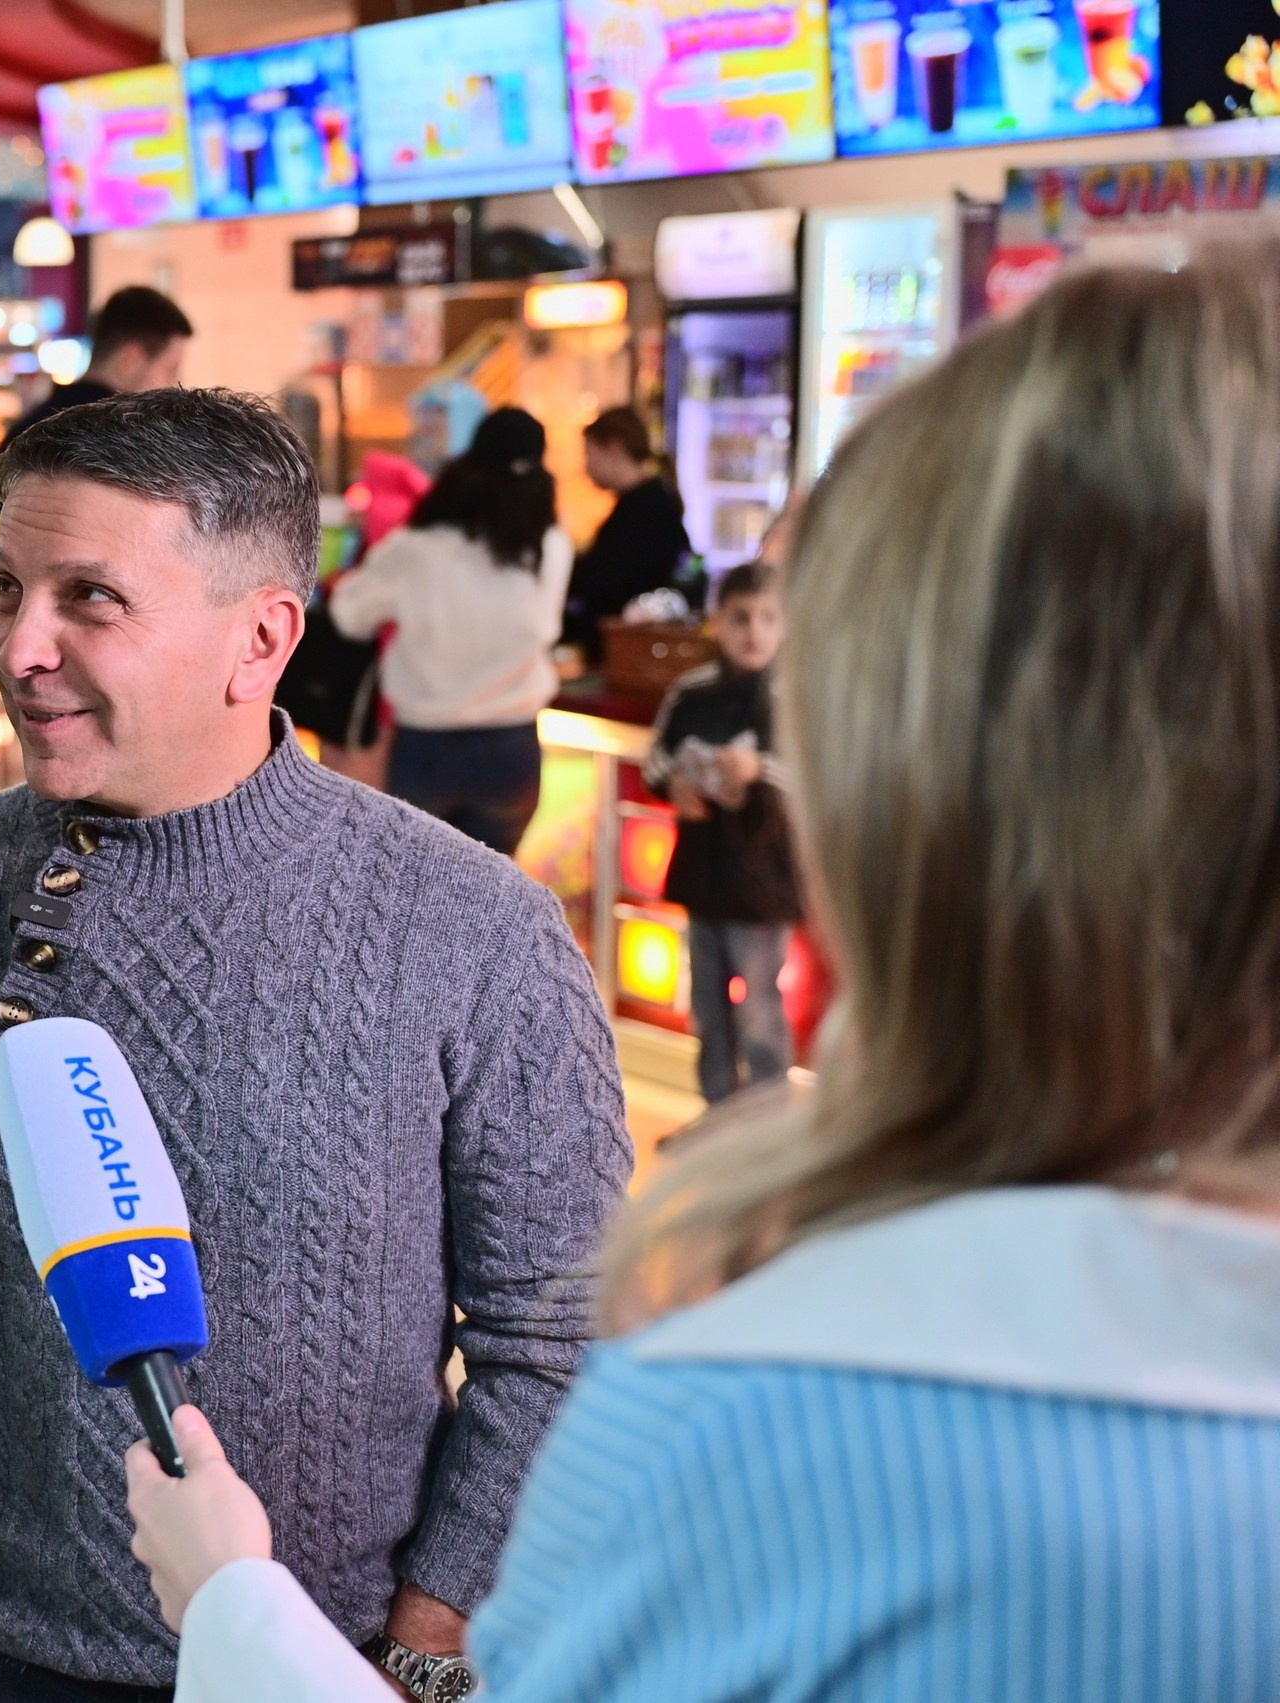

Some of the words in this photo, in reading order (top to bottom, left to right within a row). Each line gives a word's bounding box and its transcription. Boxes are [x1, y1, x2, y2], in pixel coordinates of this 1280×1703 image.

[1078, 159, 1267, 218] СЛАШ
[64, 1056, 141, 1221] КУБАНЬ
[127, 1252, 167, 1300] 24
